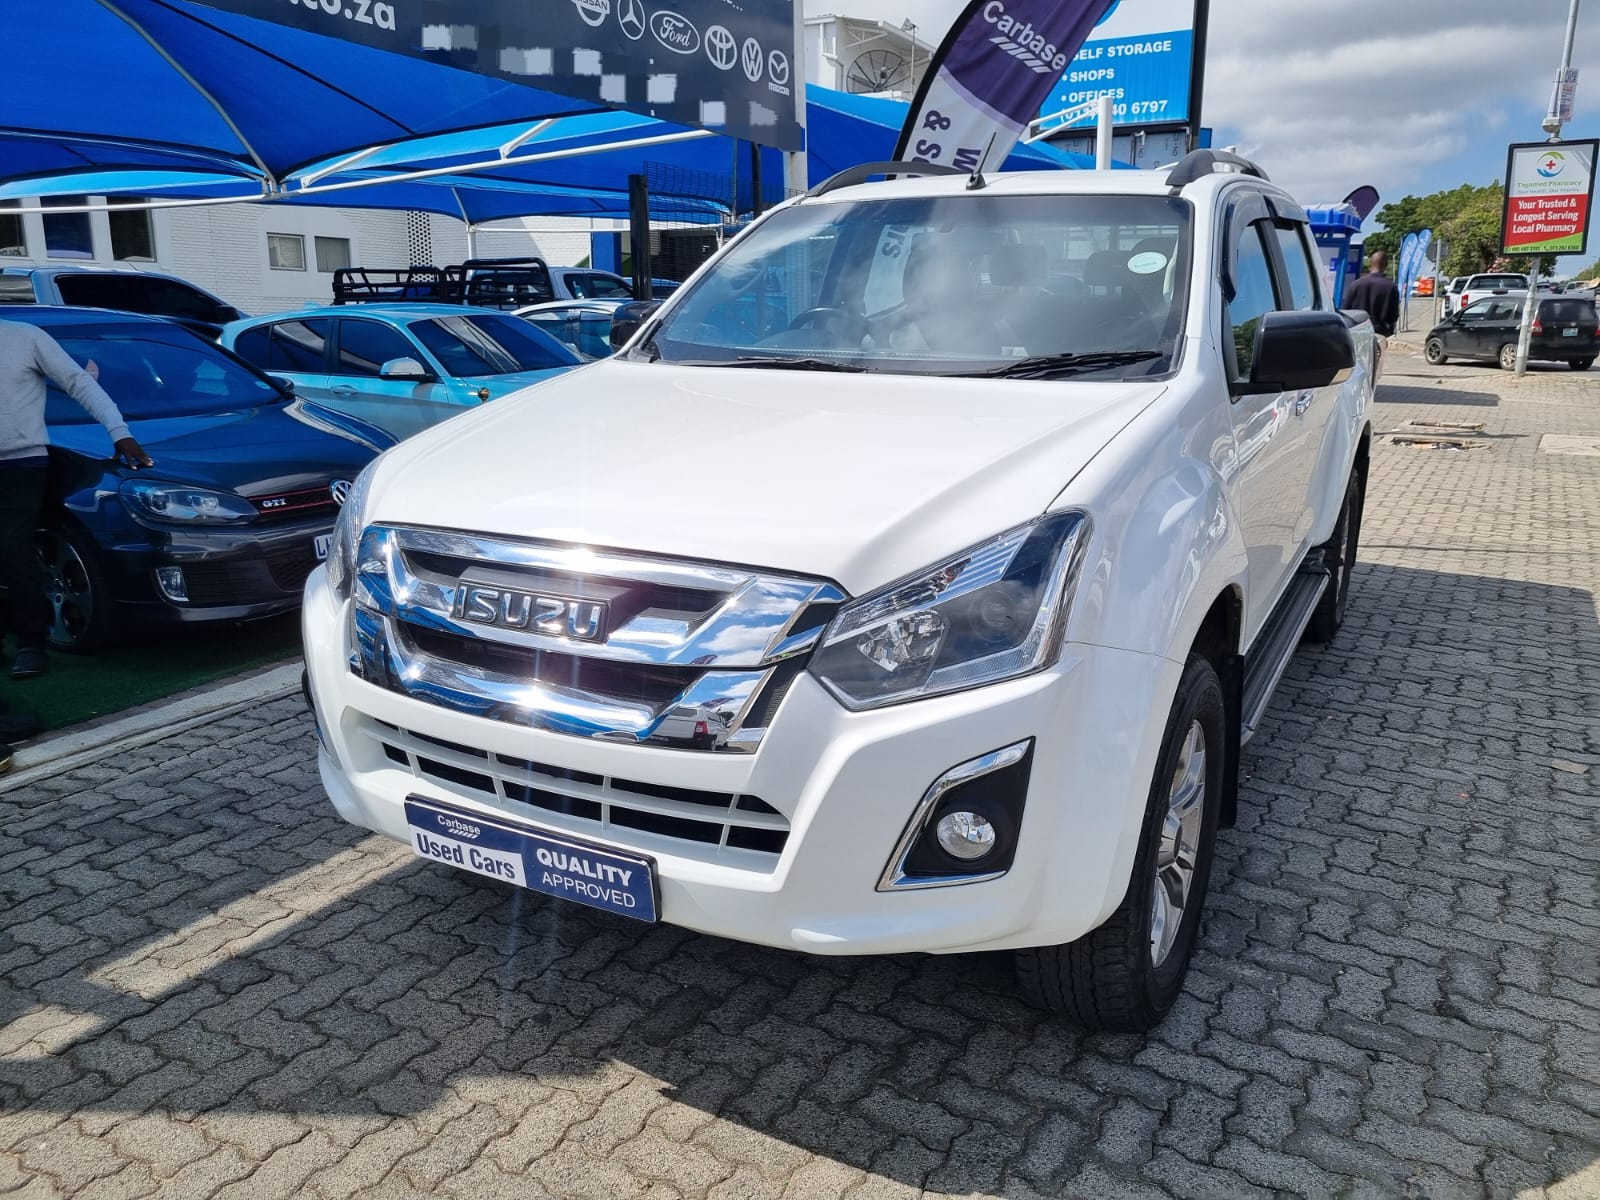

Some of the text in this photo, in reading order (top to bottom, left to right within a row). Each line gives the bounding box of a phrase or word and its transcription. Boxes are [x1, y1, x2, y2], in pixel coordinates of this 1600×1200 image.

[660, 16, 692, 47] Ford
[983, 1, 1067, 71] Carbase
[1107, 40, 1172, 57] STORAGE
[1070, 68, 1115, 83] SHOPS
[1131, 100, 1168, 114] 6797
[1518, 198, 1577, 210] Your Trusted &
[1513, 211, 1579, 223] Longest Serving
[1512, 223, 1577, 234] Local Pharmacy
[262, 498, 288, 508] GTI
[455, 586, 601, 639] ISUZU
[437, 814, 481, 836] Carbase
[416, 832, 516, 880] Used Cars
[536, 848, 633, 887] QUALITY
[542, 871, 636, 909] APPROVED
